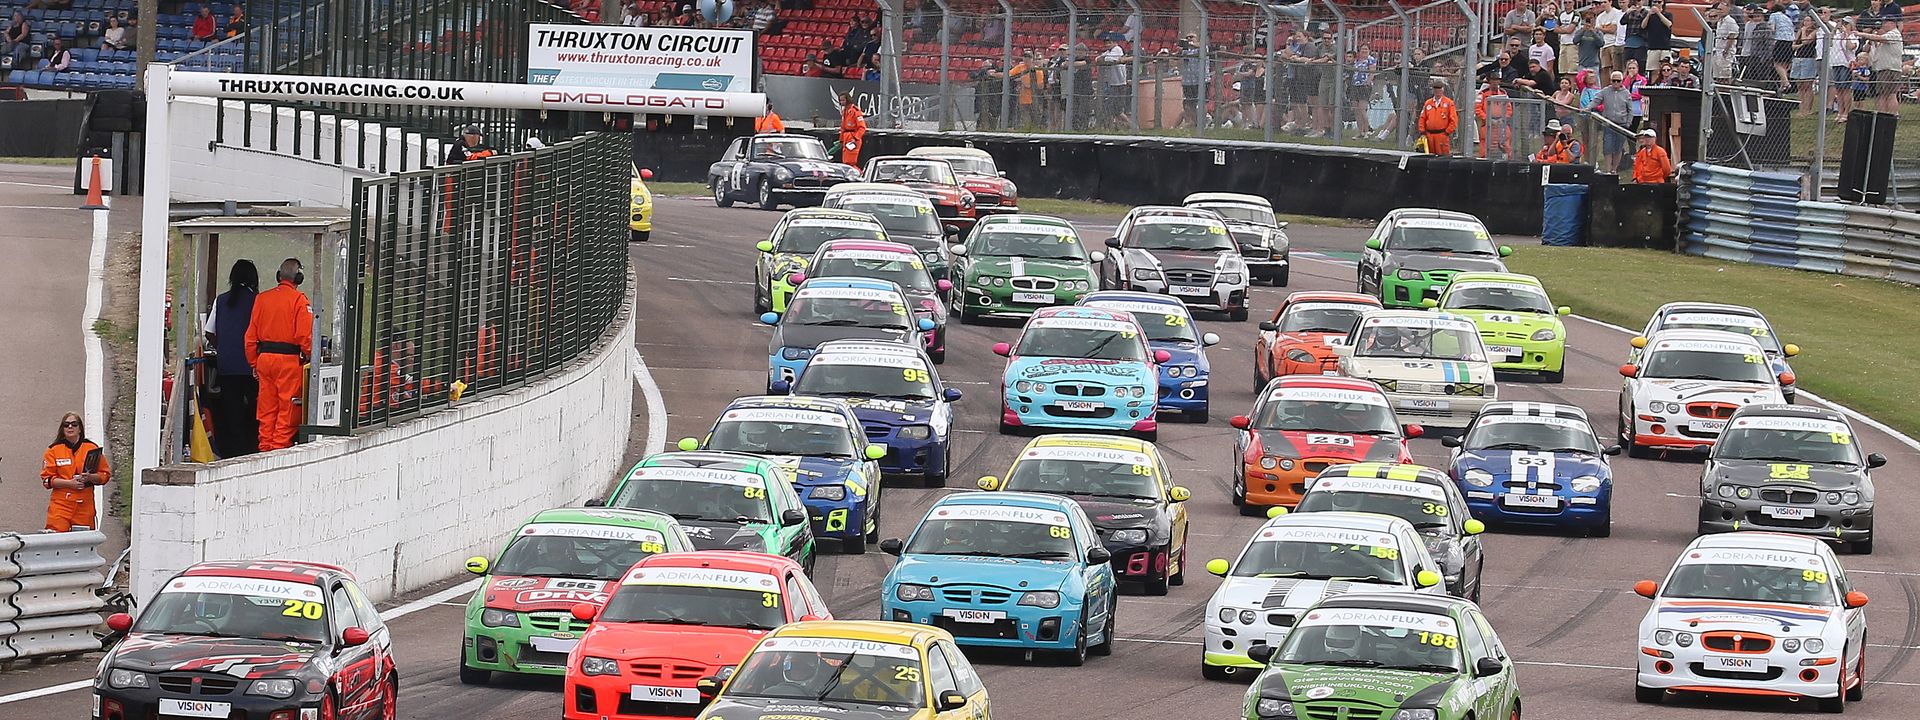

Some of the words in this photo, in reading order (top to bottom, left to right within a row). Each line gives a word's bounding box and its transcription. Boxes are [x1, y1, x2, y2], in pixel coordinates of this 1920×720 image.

[536, 29, 650, 51] THRUXTON
[657, 34, 744, 54] CIRCUIT
[557, 51, 722, 69] www.thruxtonracing.co.uk
[533, 74, 548, 83] THE
[218, 79, 465, 100] THRUXTONRACING.CO.UK
[542, 91, 724, 109] OMOLOGATO
[1208, 226, 1226, 236] 100
[1179, 285, 1200, 294] VISION
[1023, 293, 1044, 301] VISION
[1164, 314, 1187, 328] 24
[1489, 315, 1514, 323] 44
[1749, 327, 1769, 338] 22
[903, 369, 930, 384] 95
[1067, 401, 1092, 409] VISION
[1313, 436, 1350, 444] 29
[1828, 431, 1850, 444] 13
[1517, 457, 1548, 466] 53
[1131, 465, 1152, 477] 88
[743, 487, 766, 500] 84
[1518, 495, 1545, 503] VISION
[1421, 502, 1448, 517] 39
[1775, 507, 1802, 515] VISION
[1049, 525, 1071, 539] 68
[640, 542, 664, 554] 66
[1376, 547, 1398, 561] 58
[1802, 569, 1828, 584] 99
[556, 581, 597, 590] 66
[761, 592, 779, 608] 31
[281, 599, 323, 621] 20
[959, 610, 990, 620] VISION
[1418, 630, 1458, 649] 188
[1720, 657, 1752, 668] VISION
[894, 665, 920, 682] 25
[648, 687, 683, 698] VISION
[177, 700, 213, 712] VISION
